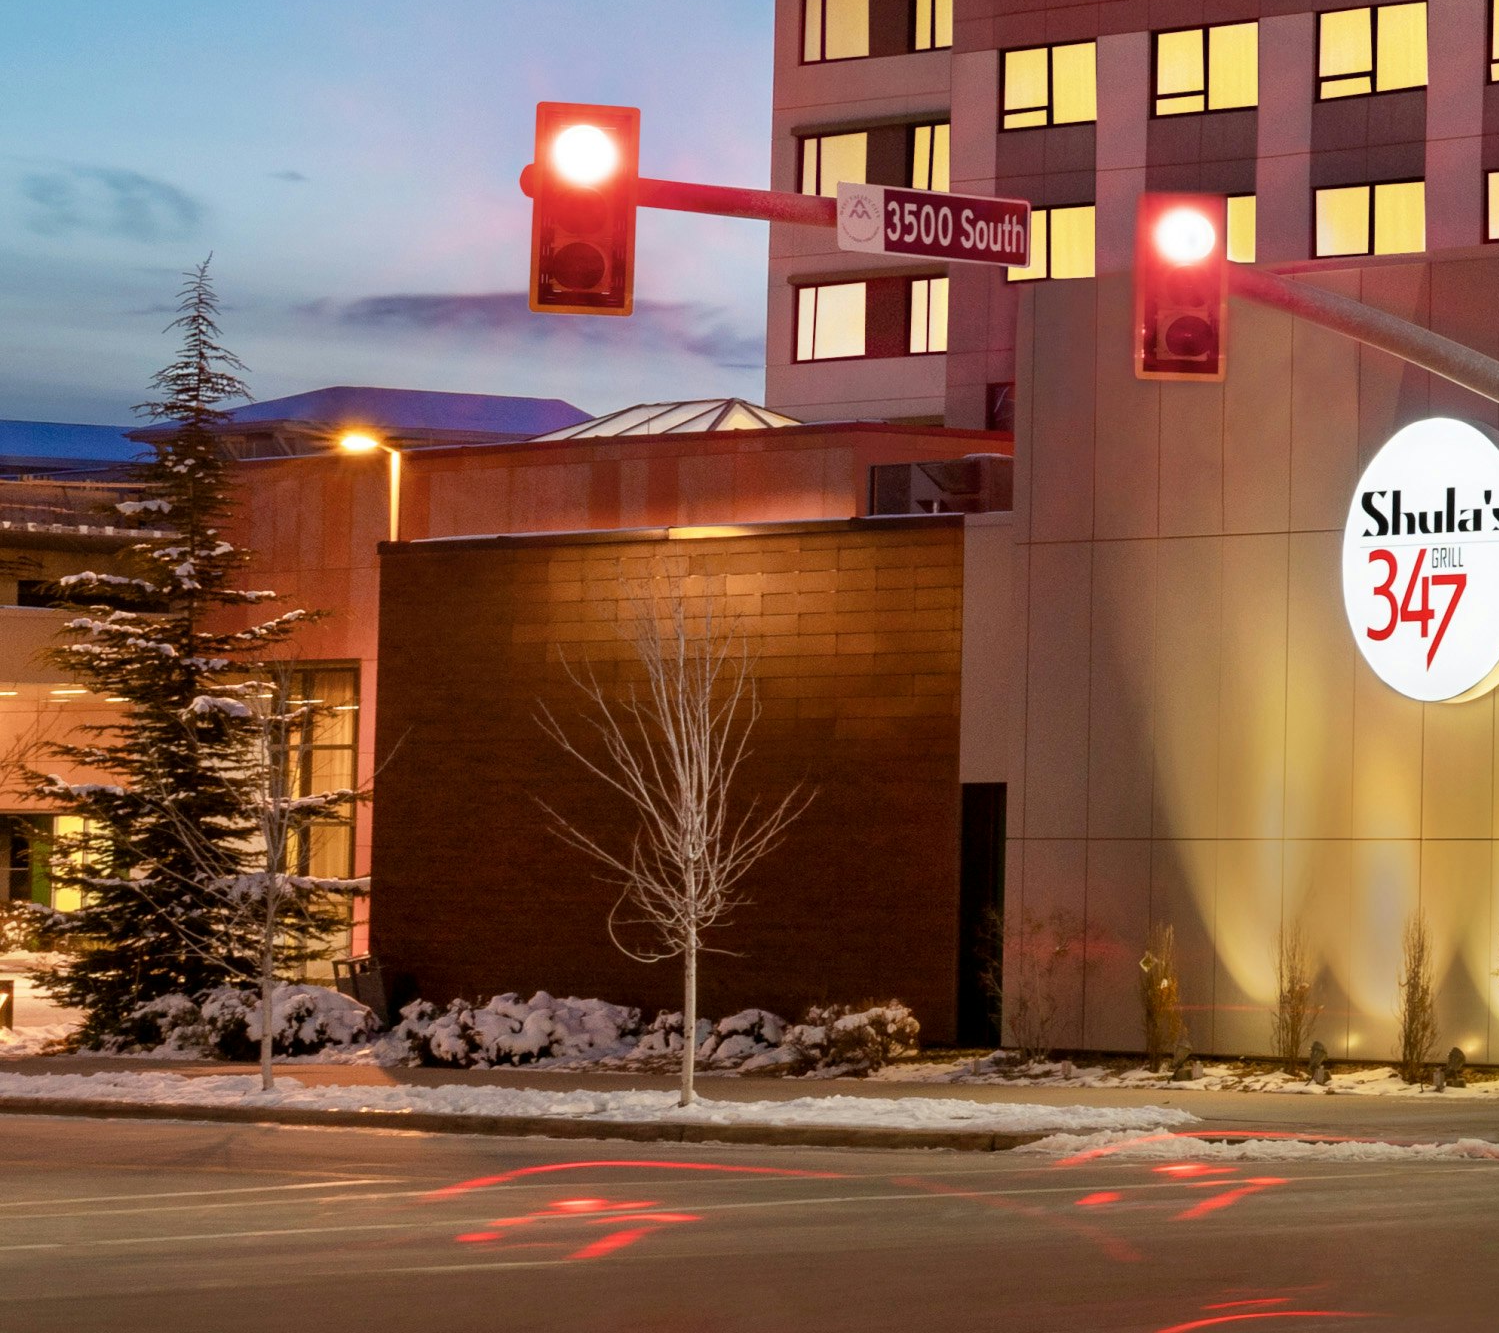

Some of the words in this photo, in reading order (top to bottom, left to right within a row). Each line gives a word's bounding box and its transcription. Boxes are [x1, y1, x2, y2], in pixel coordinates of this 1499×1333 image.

[886, 200, 953, 247] 3500
[960, 208, 1025, 254] South
[1366, 547, 1468, 673] 347
[1431, 546, 1464, 569] GRILL
